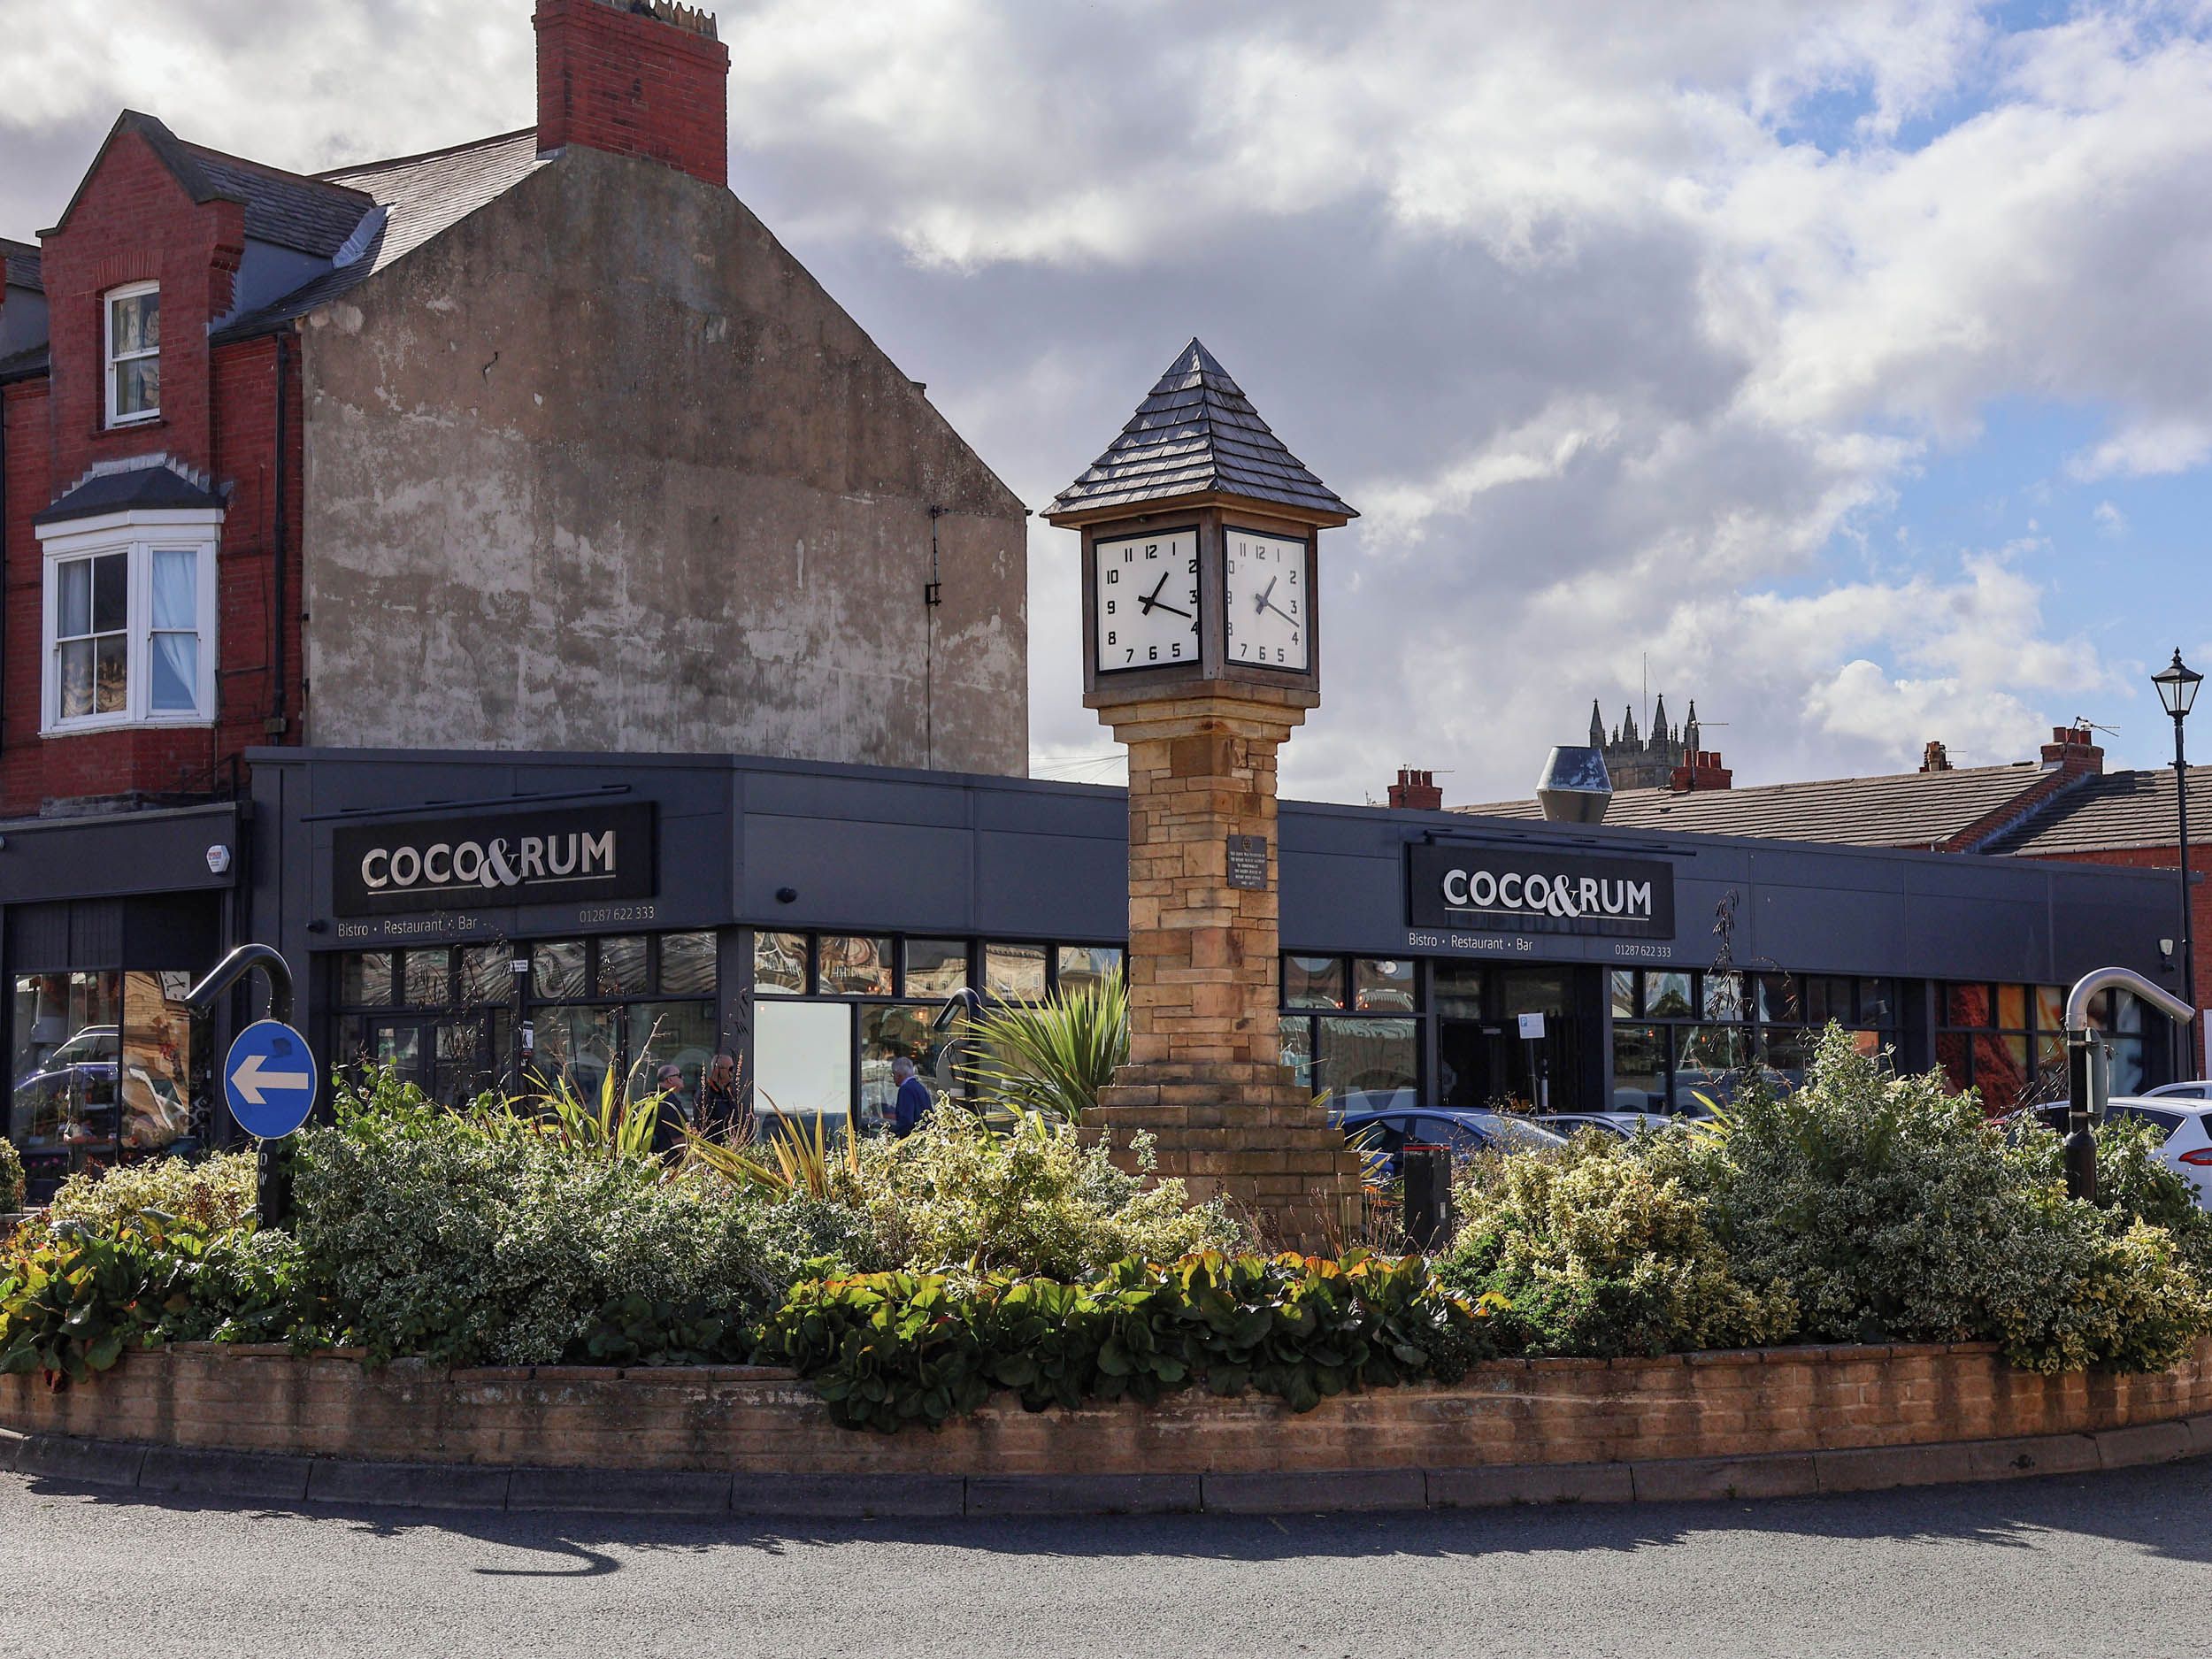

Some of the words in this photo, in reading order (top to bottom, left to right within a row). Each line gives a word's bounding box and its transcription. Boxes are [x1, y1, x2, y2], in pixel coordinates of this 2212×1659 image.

[1125, 548, 1133, 563] 11
[1145, 544, 1157, 559] 12
[1172, 541, 1175, 556] 1
[1240, 542, 1246, 557] 11
[1256, 545, 1265, 560] 12
[1188, 559, 1197, 573] 2
[1107, 569, 1118, 585] 10
[1289, 570, 1296, 584] 2
[1189, 590, 1197, 604] 3
[1107, 600, 1116, 614] 9
[1290, 600, 1297, 614] 3
[1190, 621, 1198, 635] 4
[1108, 631, 1117, 645] 8
[1291, 631, 1299, 645] 4
[1125, 649, 1134, 663] 7
[1149, 646, 1157, 660] 6
[1171, 643, 1180, 657] 5
[1240, 643, 1248, 657] 7
[1259, 646, 1266, 660] 6
[1277, 648, 1285, 662] 5
[580, 909, 611, 923] 01287
[613, 907, 633, 921] 622
[635, 905, 655, 919] 333
[338, 923, 369, 937] Bistro
[384, 918, 443, 934] Restaurant
[458, 916, 478, 930] Bar
[1409, 932, 1438, 947] Bistro
[1451, 934, 1503, 949] Restaurant
[1517, 937, 1533, 951] Bar
[1615, 944, 1640, 956] 01287
[1640, 945, 1655, 956] 622
[1656, 947, 1671, 957] 333
